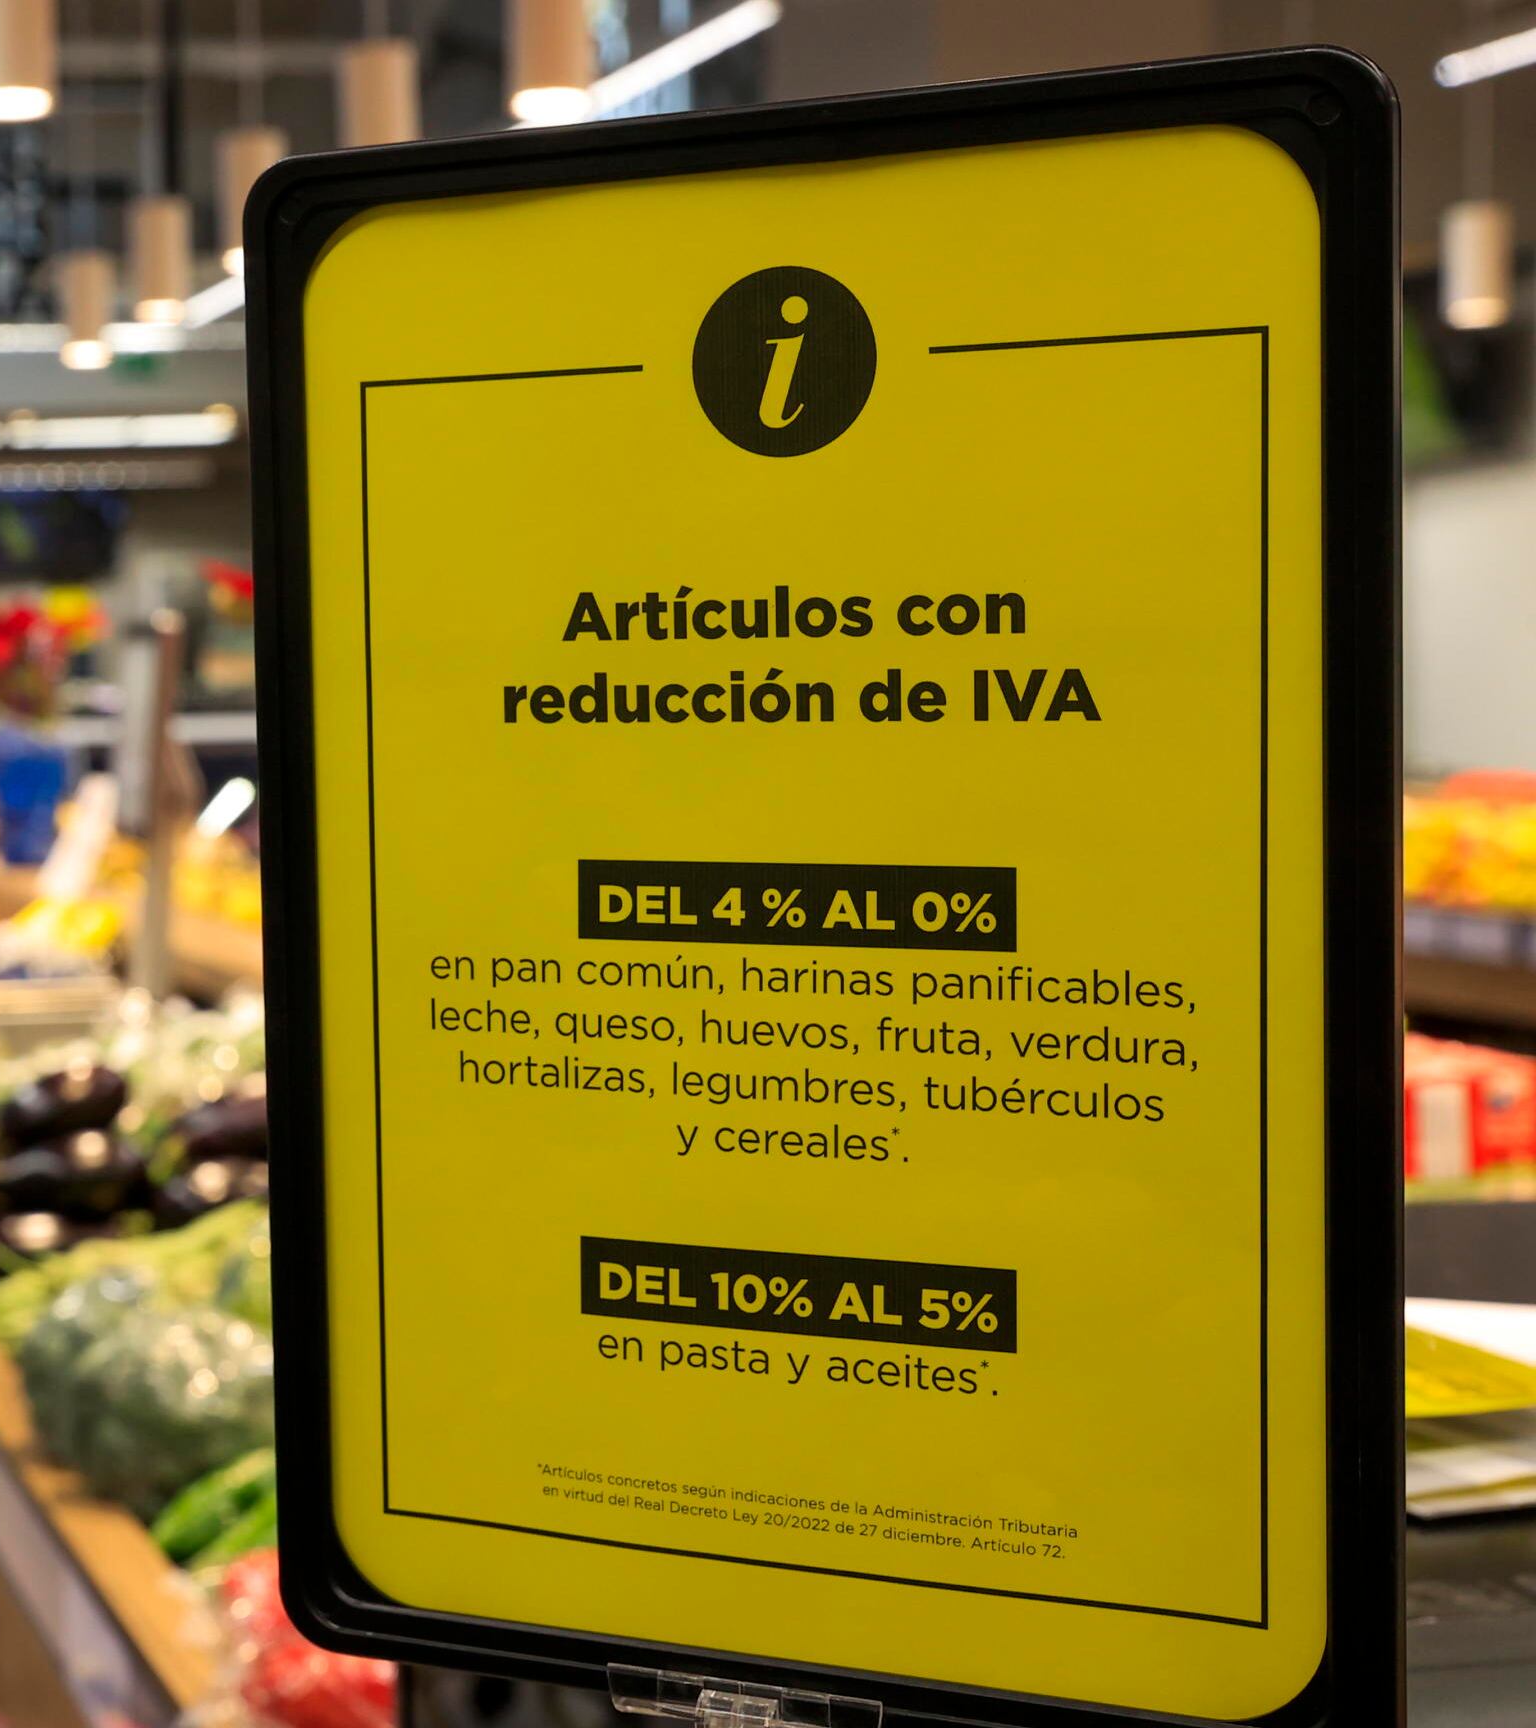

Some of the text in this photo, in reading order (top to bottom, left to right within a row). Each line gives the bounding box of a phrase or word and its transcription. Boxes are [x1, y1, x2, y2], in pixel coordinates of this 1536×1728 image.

[561, 584, 1026, 642] Artículos con
[503, 666, 1103, 725] reducción de IVA
[599, 884, 698, 925] DEL
[822, 889, 896, 931] AL
[912, 891, 997, 934] 0%
[430, 954, 1196, 1015] en pan común, harinas panificables,
[430, 997, 1198, 1073] leche, queso, huevos, fruta, verdura,
[459, 1049, 1165, 1123] hortalizas, legumbres, tubérculos
[676, 1124, 699, 1157] y
[599, 1261, 999, 1334] DEL 10% AL 5%
[597, 1334, 644, 1363] en
[660, 1340, 770, 1375] pasta
[786, 1352, 811, 1385] y
[542, 1486, 559, 1496] en
[563, 1489, 604, 1504] virtud
[607, 1492, 630, 1507] del
[634, 1496, 665, 1512] Real
[669, 1500, 728, 1520] Decreto
[732, 1508, 759, 1526] Ley
[763, 1512, 830, 1533] 20/2022
[834, 1521, 855, 1535] de
[859, 1523, 878, 1537] 27
[1042, 1543, 1066, 1559] 72.
[607, 1475, 678, 1493] concretos
[682, 1484, 726, 1500] según
[731, 1490, 826, 1511] indicaciones
[830, 1499, 850, 1514] de
[855, 1501, 868, 1516] la
[872, 1504, 993, 1530] Administración
[998, 1517, 1078, 1539] Tributaria
